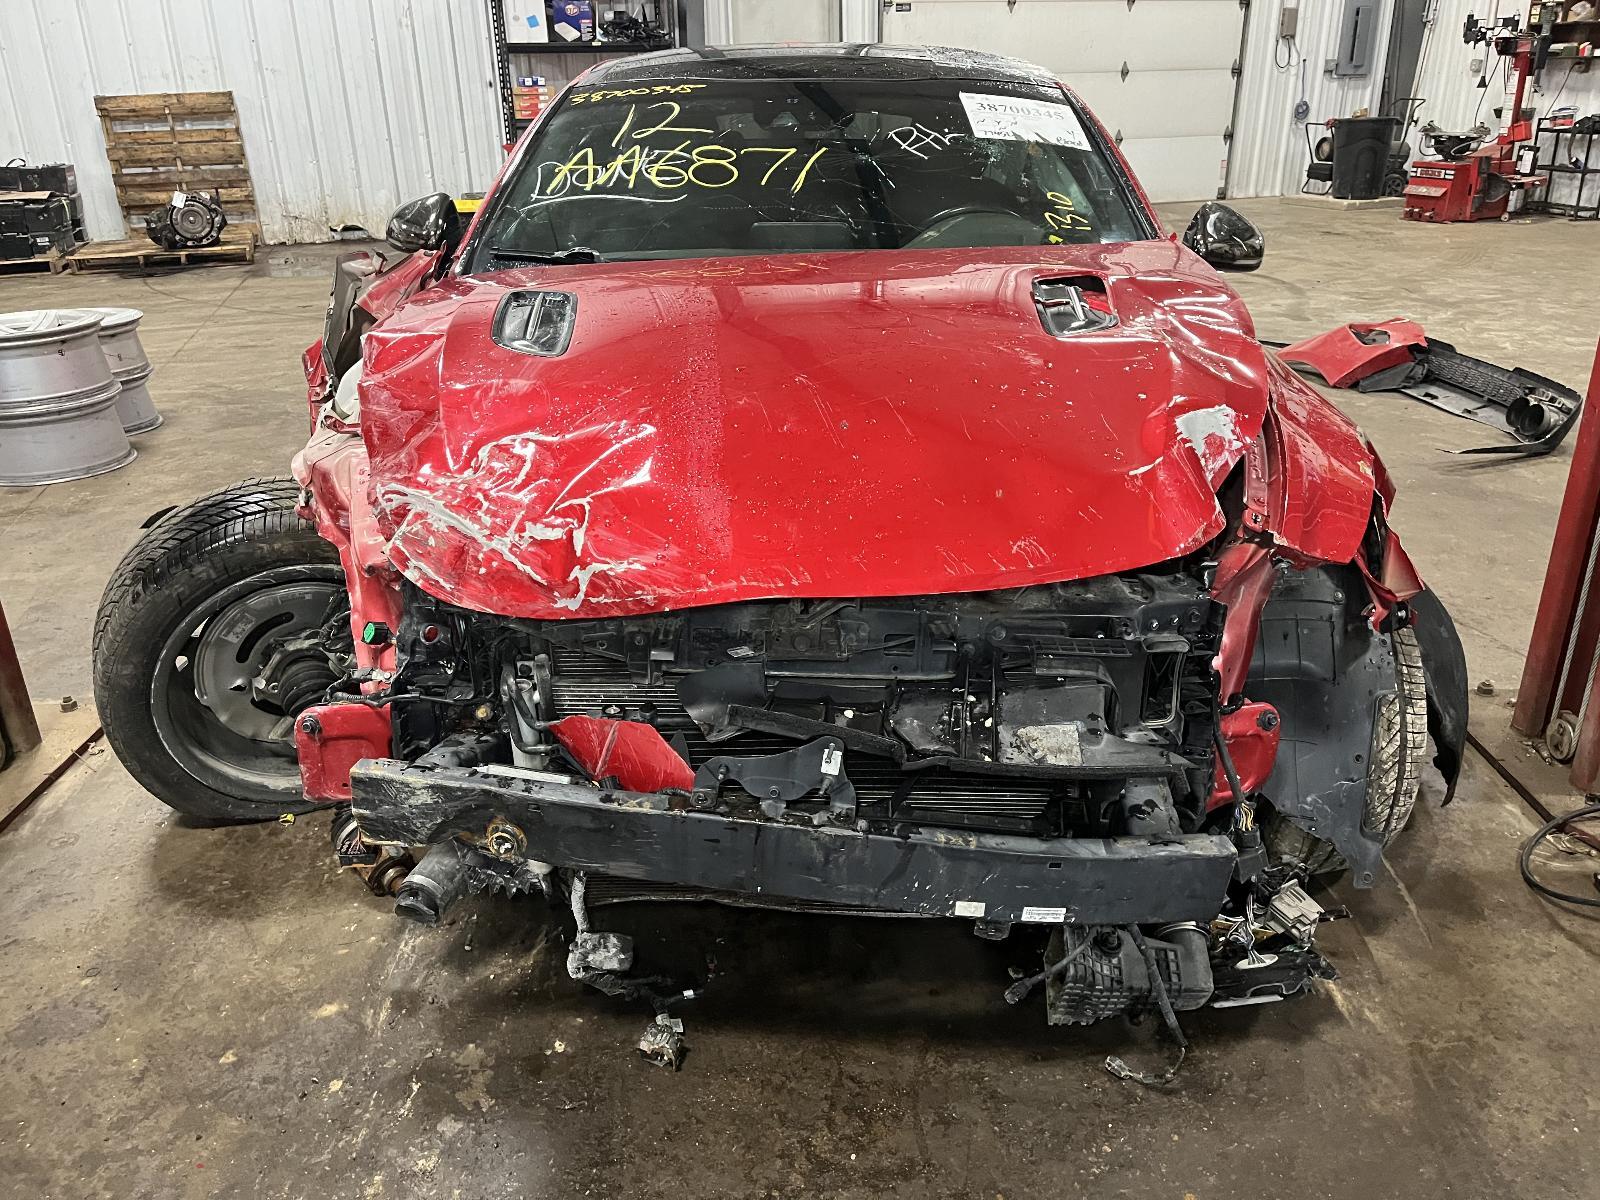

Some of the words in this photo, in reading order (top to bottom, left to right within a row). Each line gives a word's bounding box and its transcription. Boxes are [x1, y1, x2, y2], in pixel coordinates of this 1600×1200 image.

[570, 84, 707, 107] 38700345
[975, 102, 1065, 122] 38700345
[611, 101, 714, 148] 12
